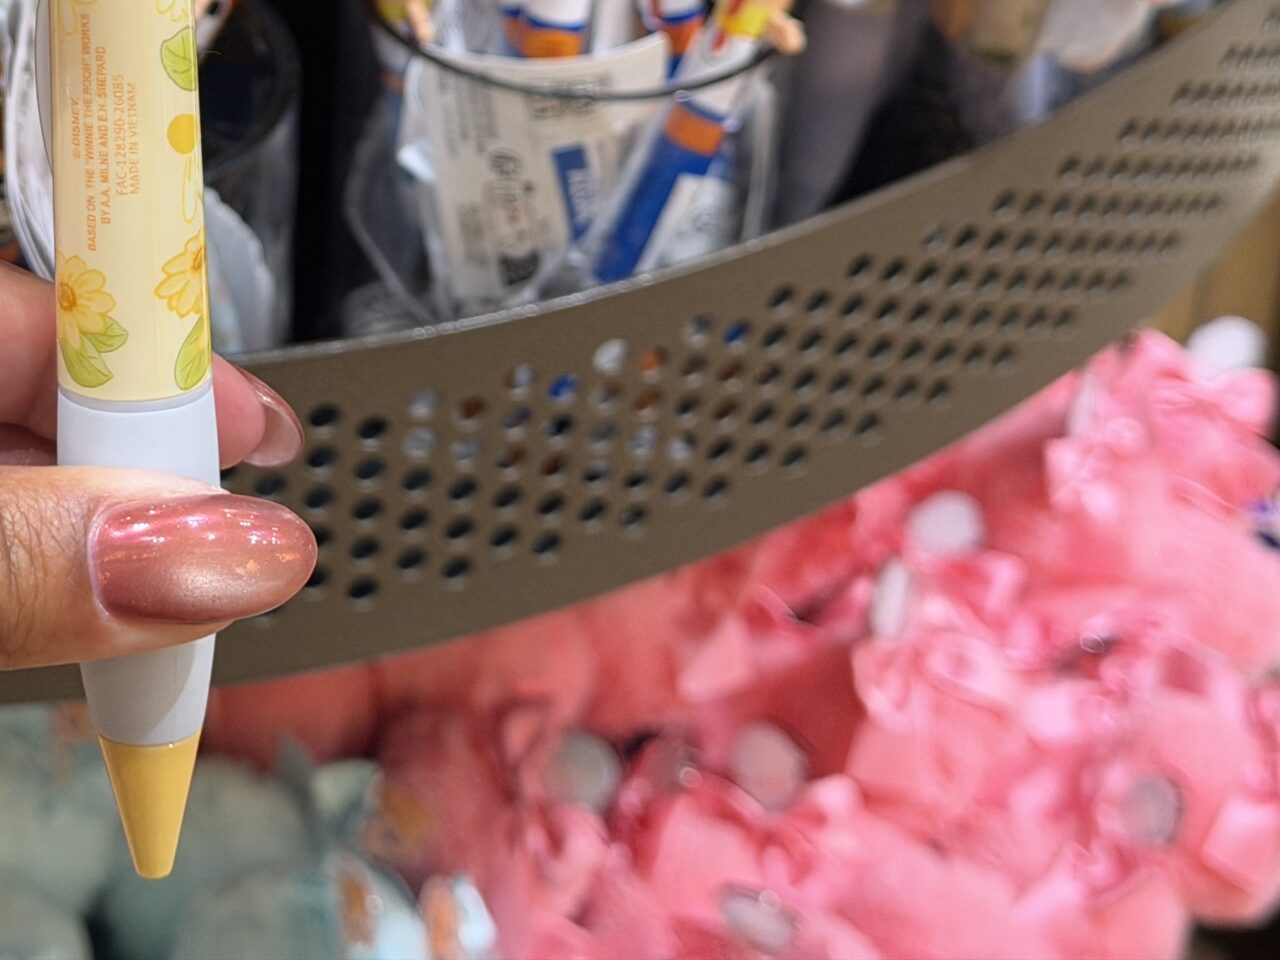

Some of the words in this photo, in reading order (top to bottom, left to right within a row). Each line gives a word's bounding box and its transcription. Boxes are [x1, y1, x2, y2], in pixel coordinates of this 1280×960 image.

[80, 14, 91, 55] WORKS
[96, 46, 108, 98] SHEPARD
[83, 96, 93, 117] THE
[126, 82, 138, 138] VIETNAM
[98, 125, 109, 148] AND
[128, 142, 138, 154] IN
[85, 168, 96, 188] THE
[98, 151, 110, 184] MILNE
[128, 158, 140, 194] MADE
[86, 195, 96, 212] ON
[100, 210, 112, 224] BY
[86, 214, 97, 252] BASED
